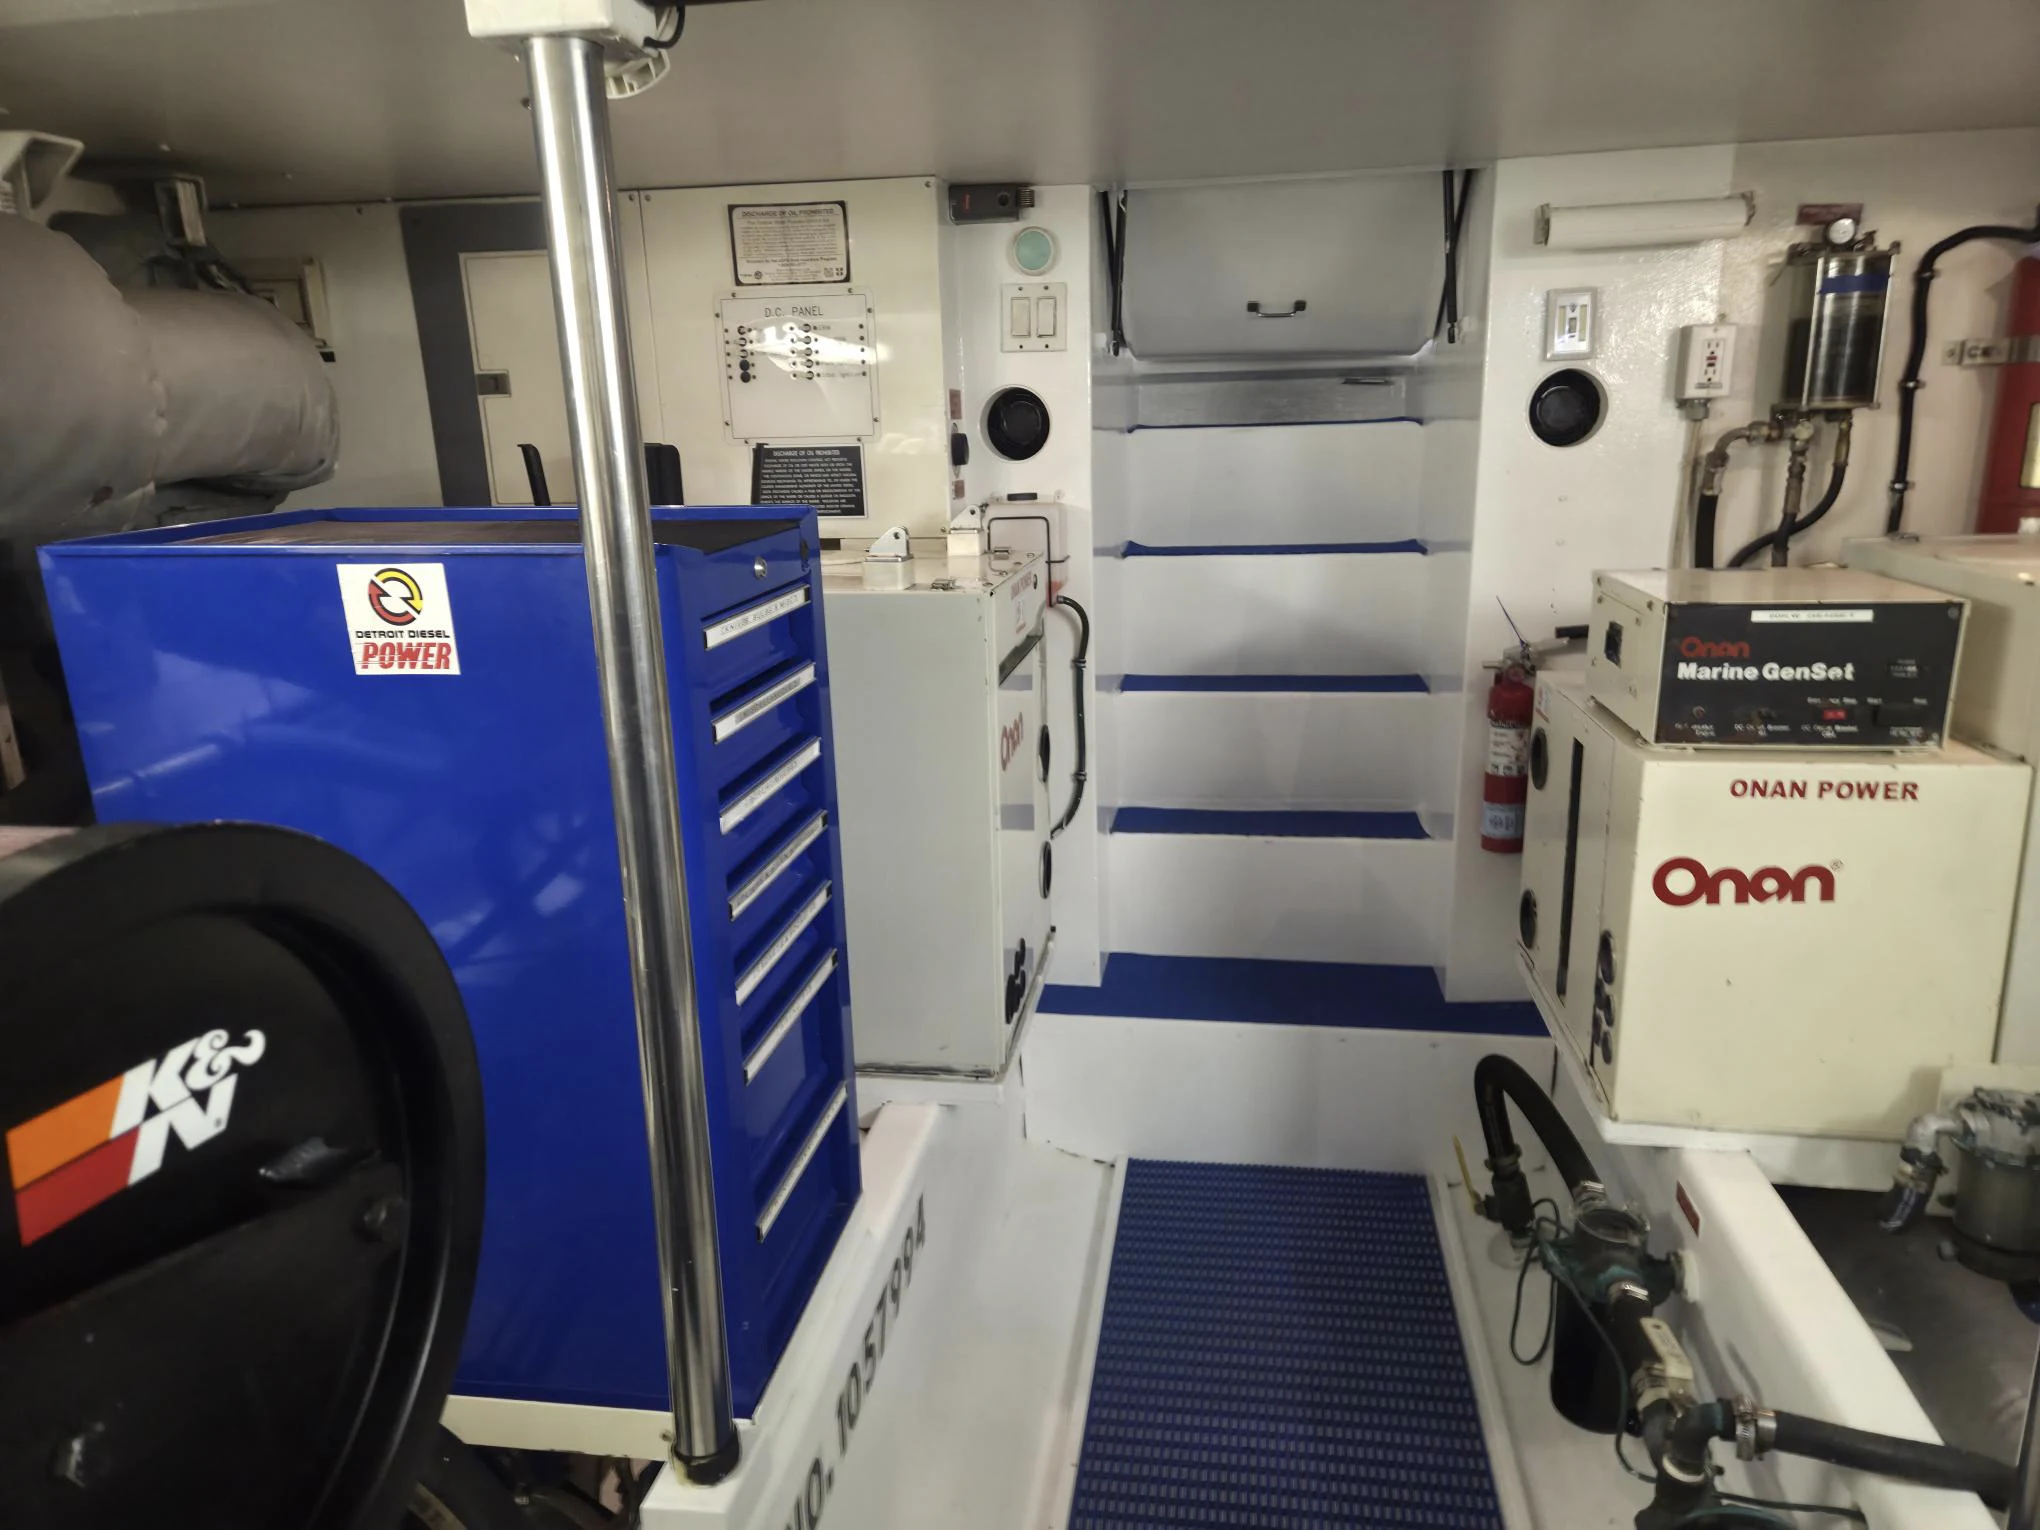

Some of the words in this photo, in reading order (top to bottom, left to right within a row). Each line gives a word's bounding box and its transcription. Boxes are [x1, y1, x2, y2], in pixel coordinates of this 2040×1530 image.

[764, 307, 785, 318] D.C.
[791, 306, 824, 317] PANEL
[355, 630, 404, 639] DETROIT
[407, 630, 451, 639] DIESEL
[361, 642, 452, 669] POWER
[1679, 636, 1750, 658] Onan
[1677, 661, 1759, 681] Marine
[1761, 661, 1856, 681] GenSet
[1729, 779, 1808, 799] ONAN
[1817, 780, 1919, 801] POWER
[1652, 856, 1836, 907] Onan
[108, 1028, 266, 1187] K&N
